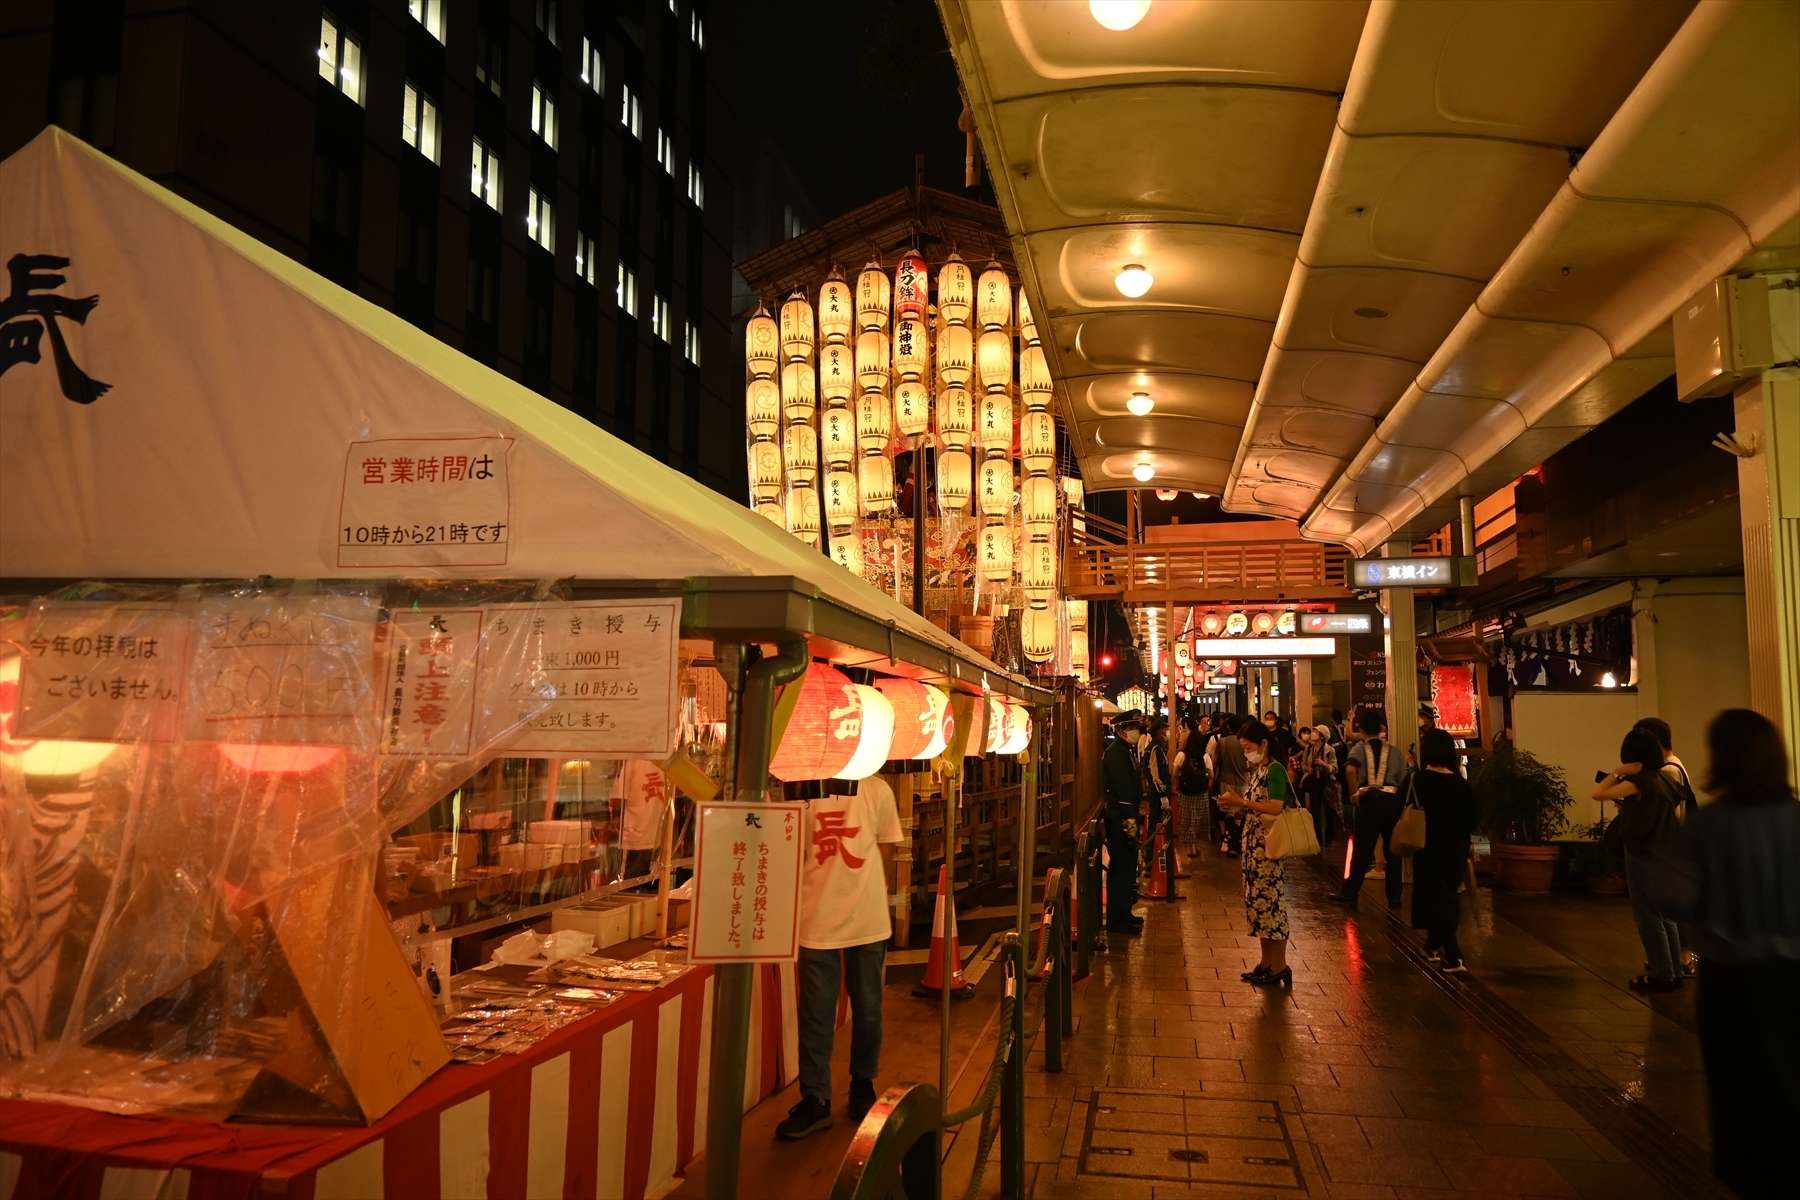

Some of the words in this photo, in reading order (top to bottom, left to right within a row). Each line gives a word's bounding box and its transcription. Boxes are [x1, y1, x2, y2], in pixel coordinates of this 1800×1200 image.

[899, 260, 915, 299] 長刀鉾
[830, 295, 839, 313] 大丸
[0, 253, 113, 405] 長
[830, 358, 840, 376] 大丸
[902, 398, 912, 416] 大丸
[986, 410, 995, 429] 大丸
[830, 423, 840, 442] 大丸
[361, 454, 494, 485] 営業時間は
[985, 477, 994, 496] 大丸
[831, 488, 841, 506] 大丸
[343, 522, 506, 545] 10時から21時です
[985, 542, 995, 560] 大丸
[1387, 565, 1438, 579] 東横イン
[496, 614, 661, 636] ちまき授与
[1348, 619, 1369, 629] 四条
[29, 634, 158, 659] 今年の拝観は
[47, 674, 177, 702] ございません。
[745, 813, 762, 829] 長
[784, 812, 794, 841] 本日の
[812, 811, 867, 869] 長
[728, 842, 747, 949] 終了致しました。
[752, 842, 769, 940] ちまきの授与は
